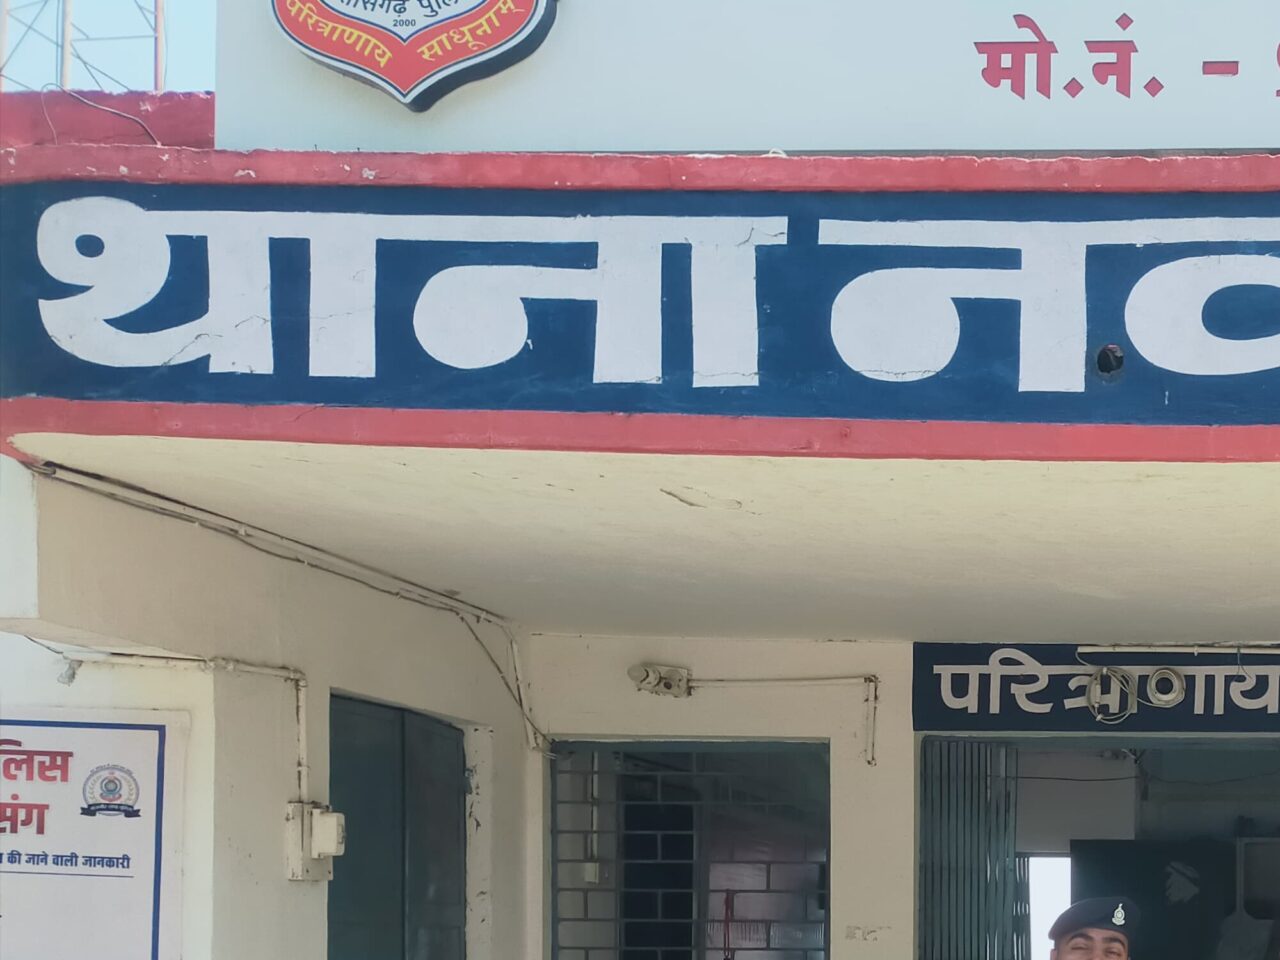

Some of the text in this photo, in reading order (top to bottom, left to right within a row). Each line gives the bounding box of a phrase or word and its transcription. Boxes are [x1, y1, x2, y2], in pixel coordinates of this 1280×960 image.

[974, 13, 1164, 100] मो.नं.
[36, 196, 789, 388] थाना
[82, 854, 131, 869] जानकारी
